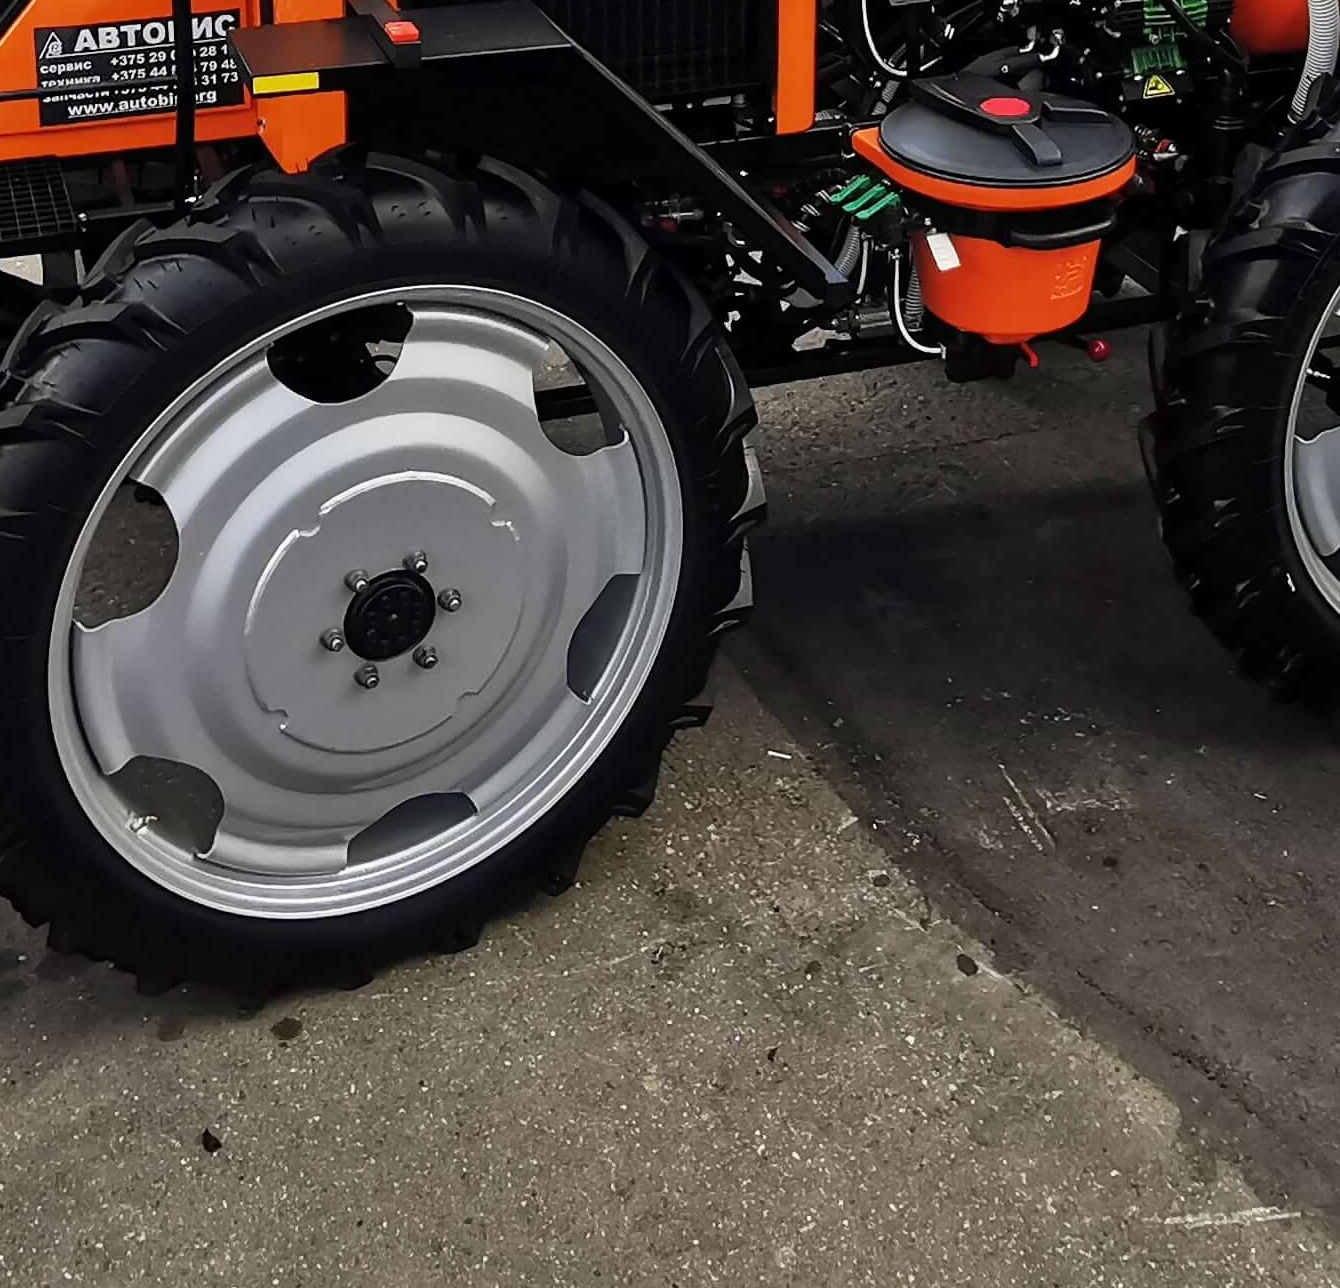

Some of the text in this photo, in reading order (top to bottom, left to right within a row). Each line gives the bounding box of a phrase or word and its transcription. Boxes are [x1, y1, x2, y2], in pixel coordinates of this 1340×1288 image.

[74, 15, 235, 51] АВТОИС
[40, 61, 92, 74] сервис
[110, 54, 145, 67] +375
[149, 51, 166, 62] 29
[200, 45, 217, 57] 28
[111, 67, 146, 81] +375
[150, 65, 167, 78] 44
[202, 61, 219, 73] 79
[200, 75, 217, 86] 31
[221, 72, 239, 84] 73
